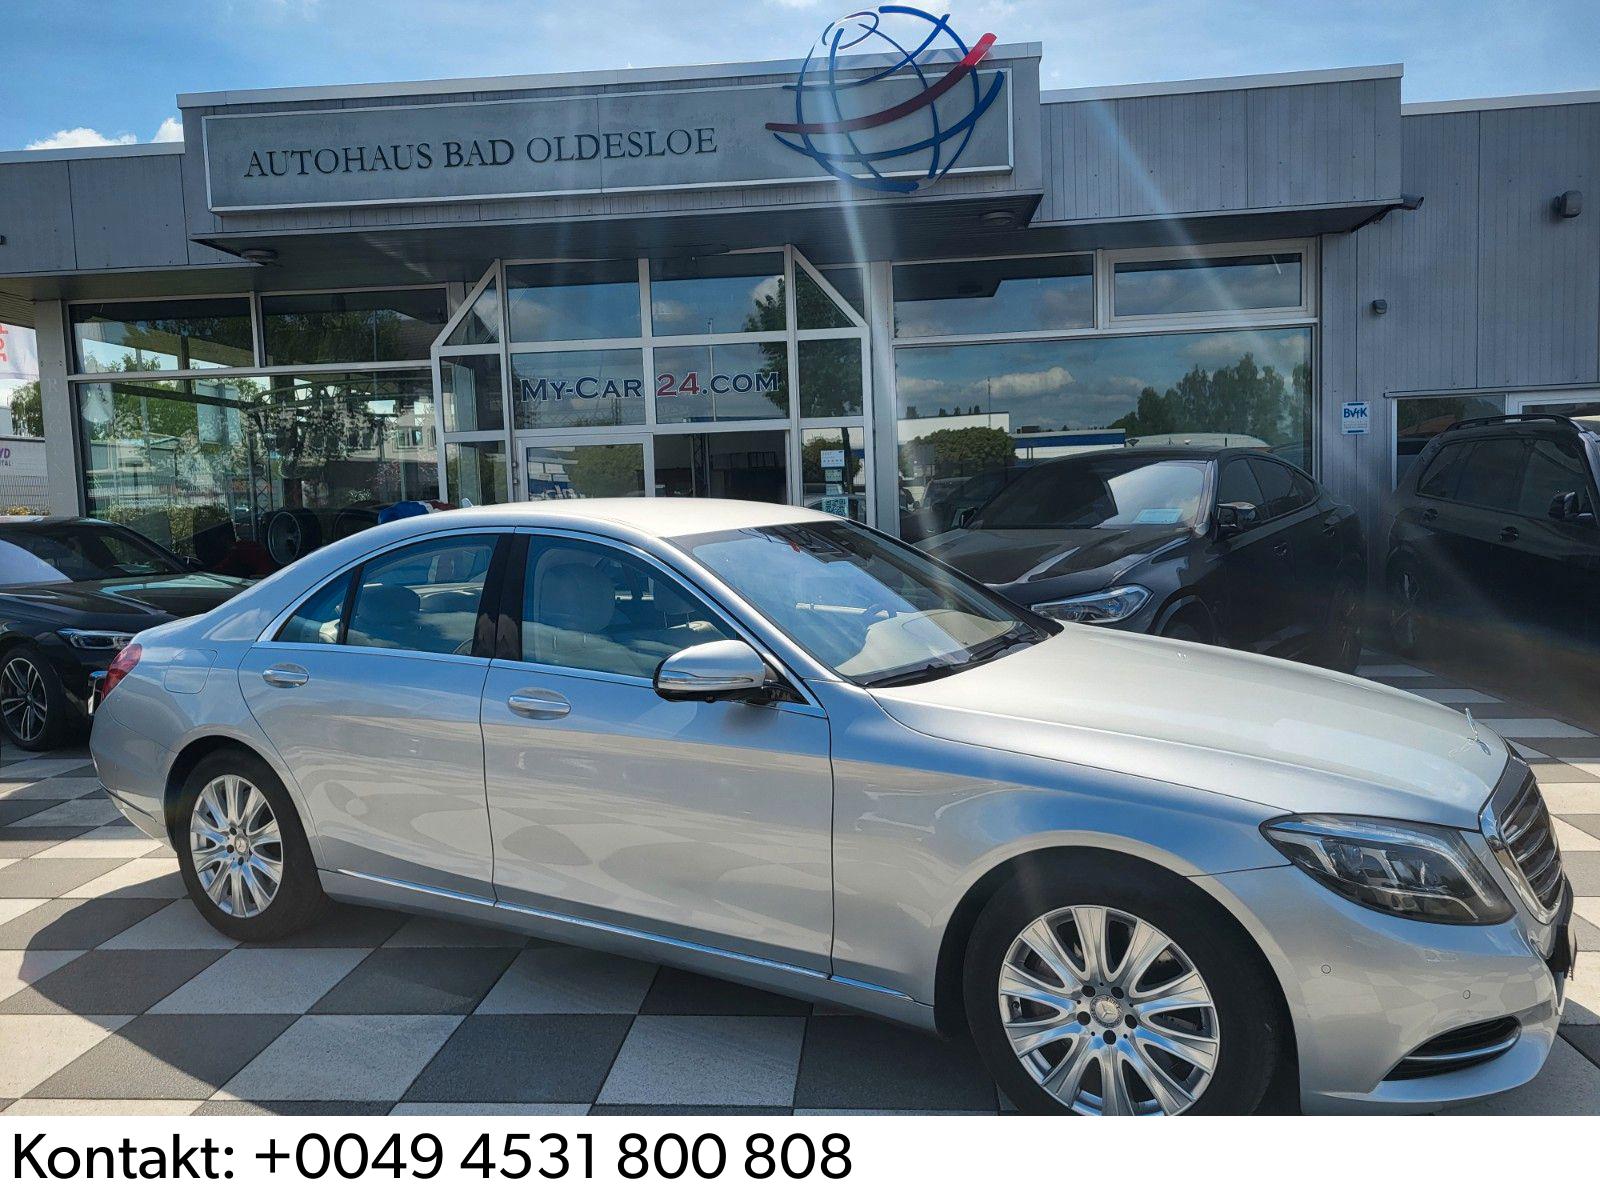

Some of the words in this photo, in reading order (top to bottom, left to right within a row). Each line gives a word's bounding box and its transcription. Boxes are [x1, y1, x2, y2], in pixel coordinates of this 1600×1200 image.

[244, 142, 433, 178] AUTOHAUS
[443, 138, 515, 169] BAD
[526, 127, 718, 163] OLDESLOE
